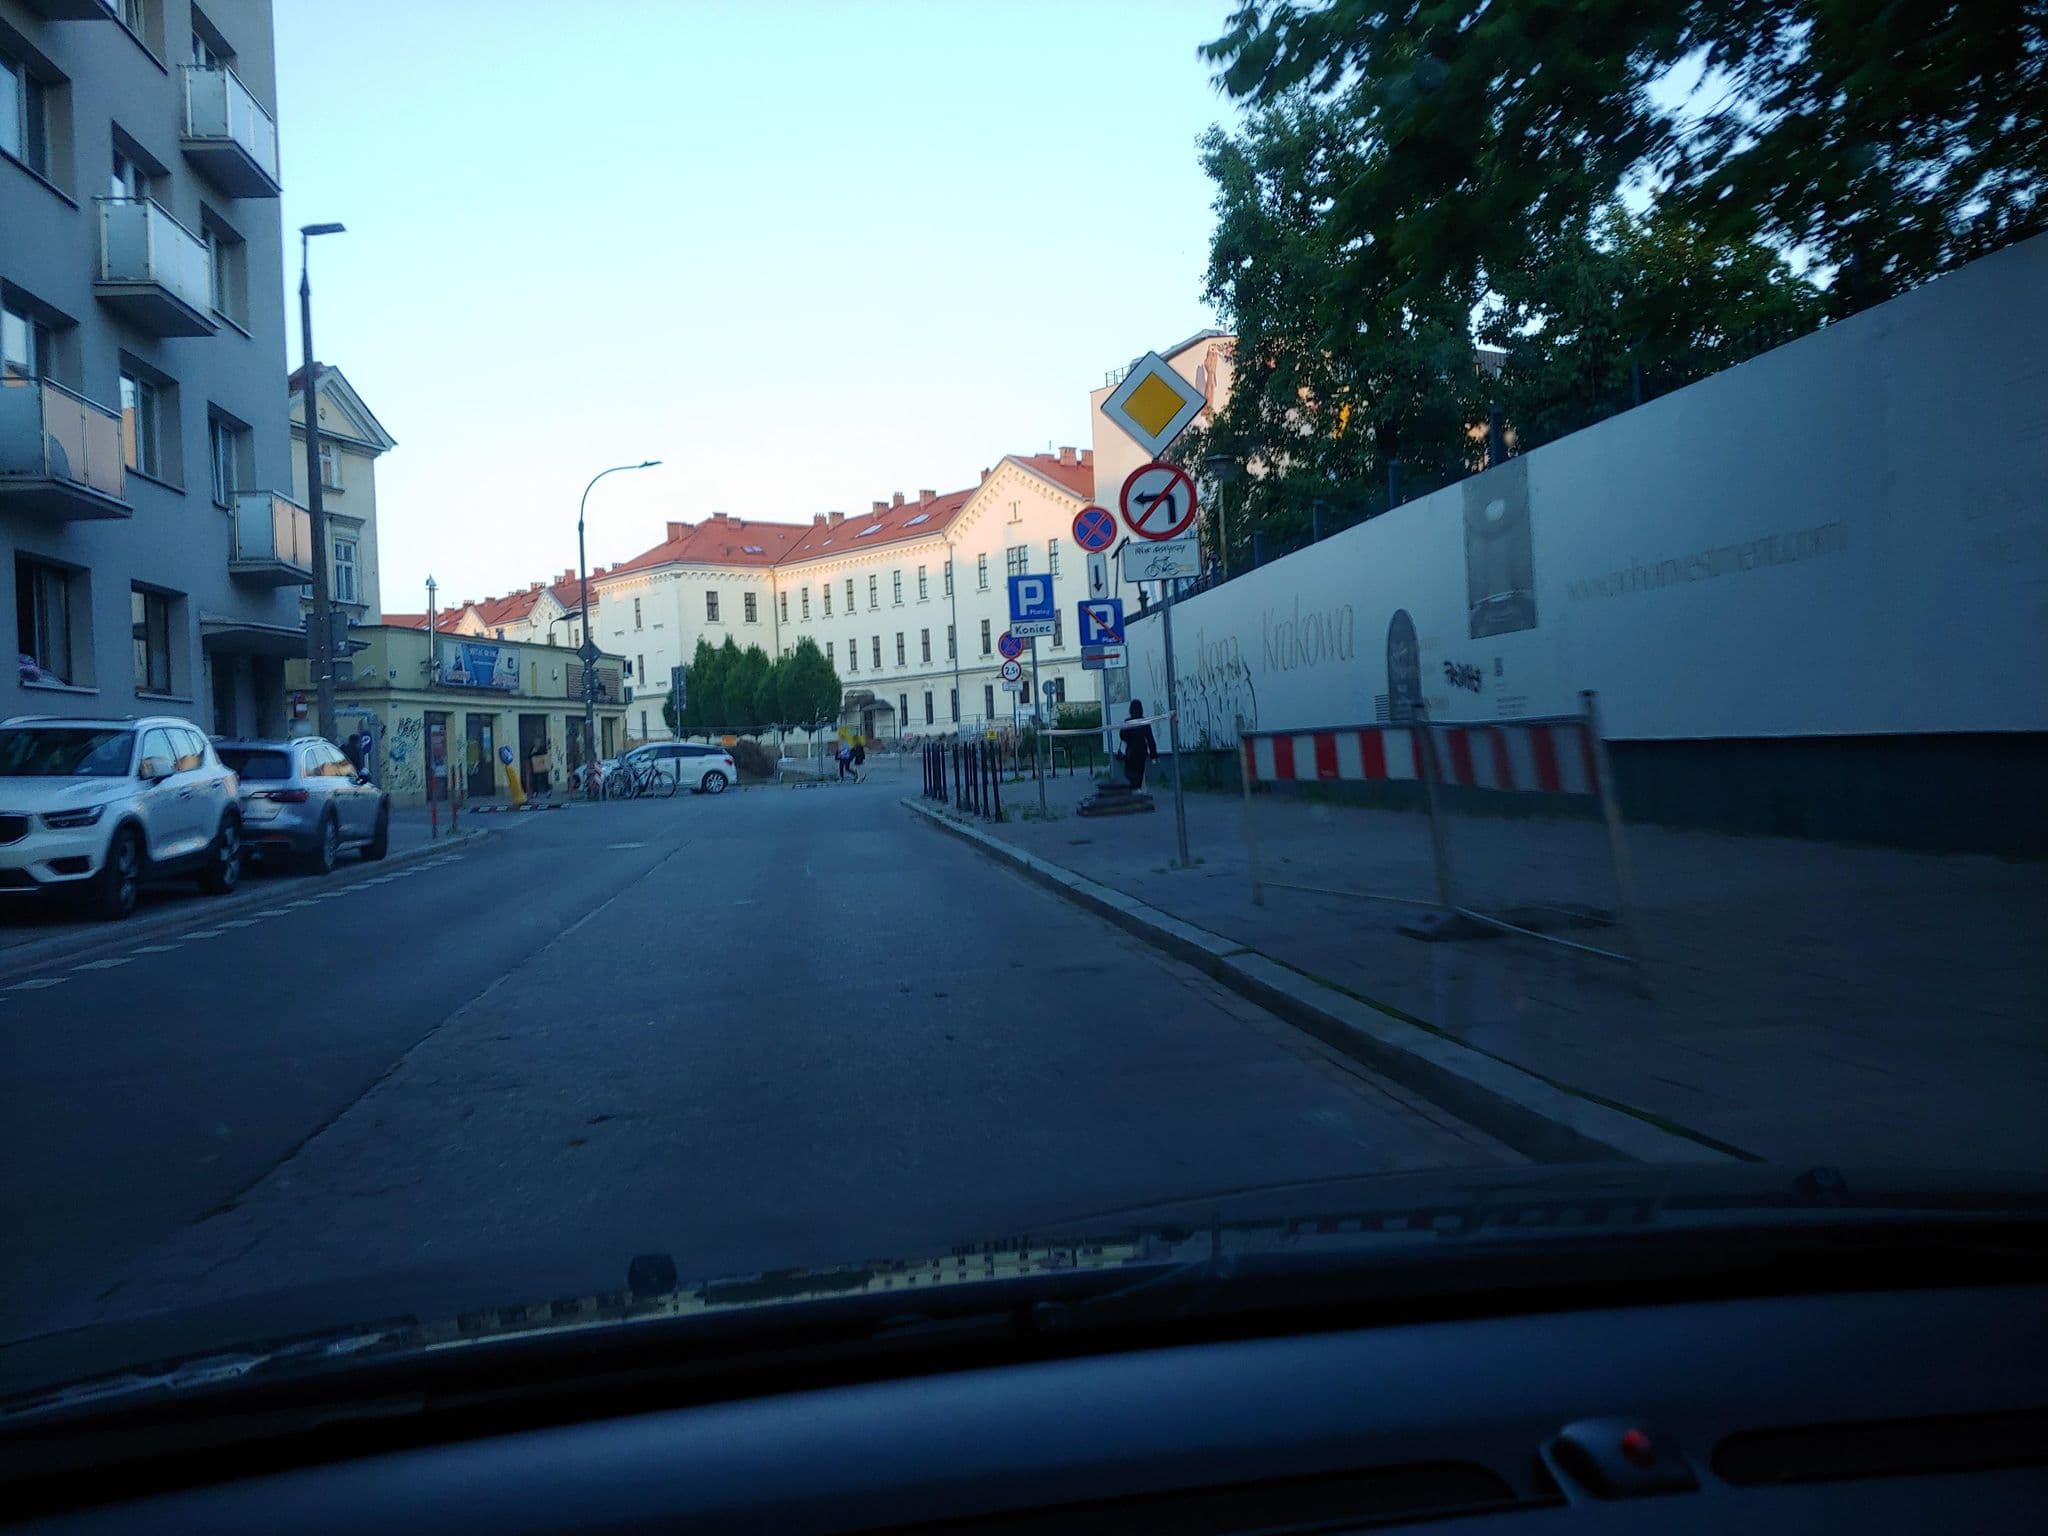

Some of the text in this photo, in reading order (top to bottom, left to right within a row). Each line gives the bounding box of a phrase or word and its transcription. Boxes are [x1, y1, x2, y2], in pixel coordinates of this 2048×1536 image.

[1018, 579, 1044, 616] P
[1015, 626, 1052, 634] Koniec
[1089, 604, 1115, 640] P
[1263, 592, 1355, 673] Krakowa
